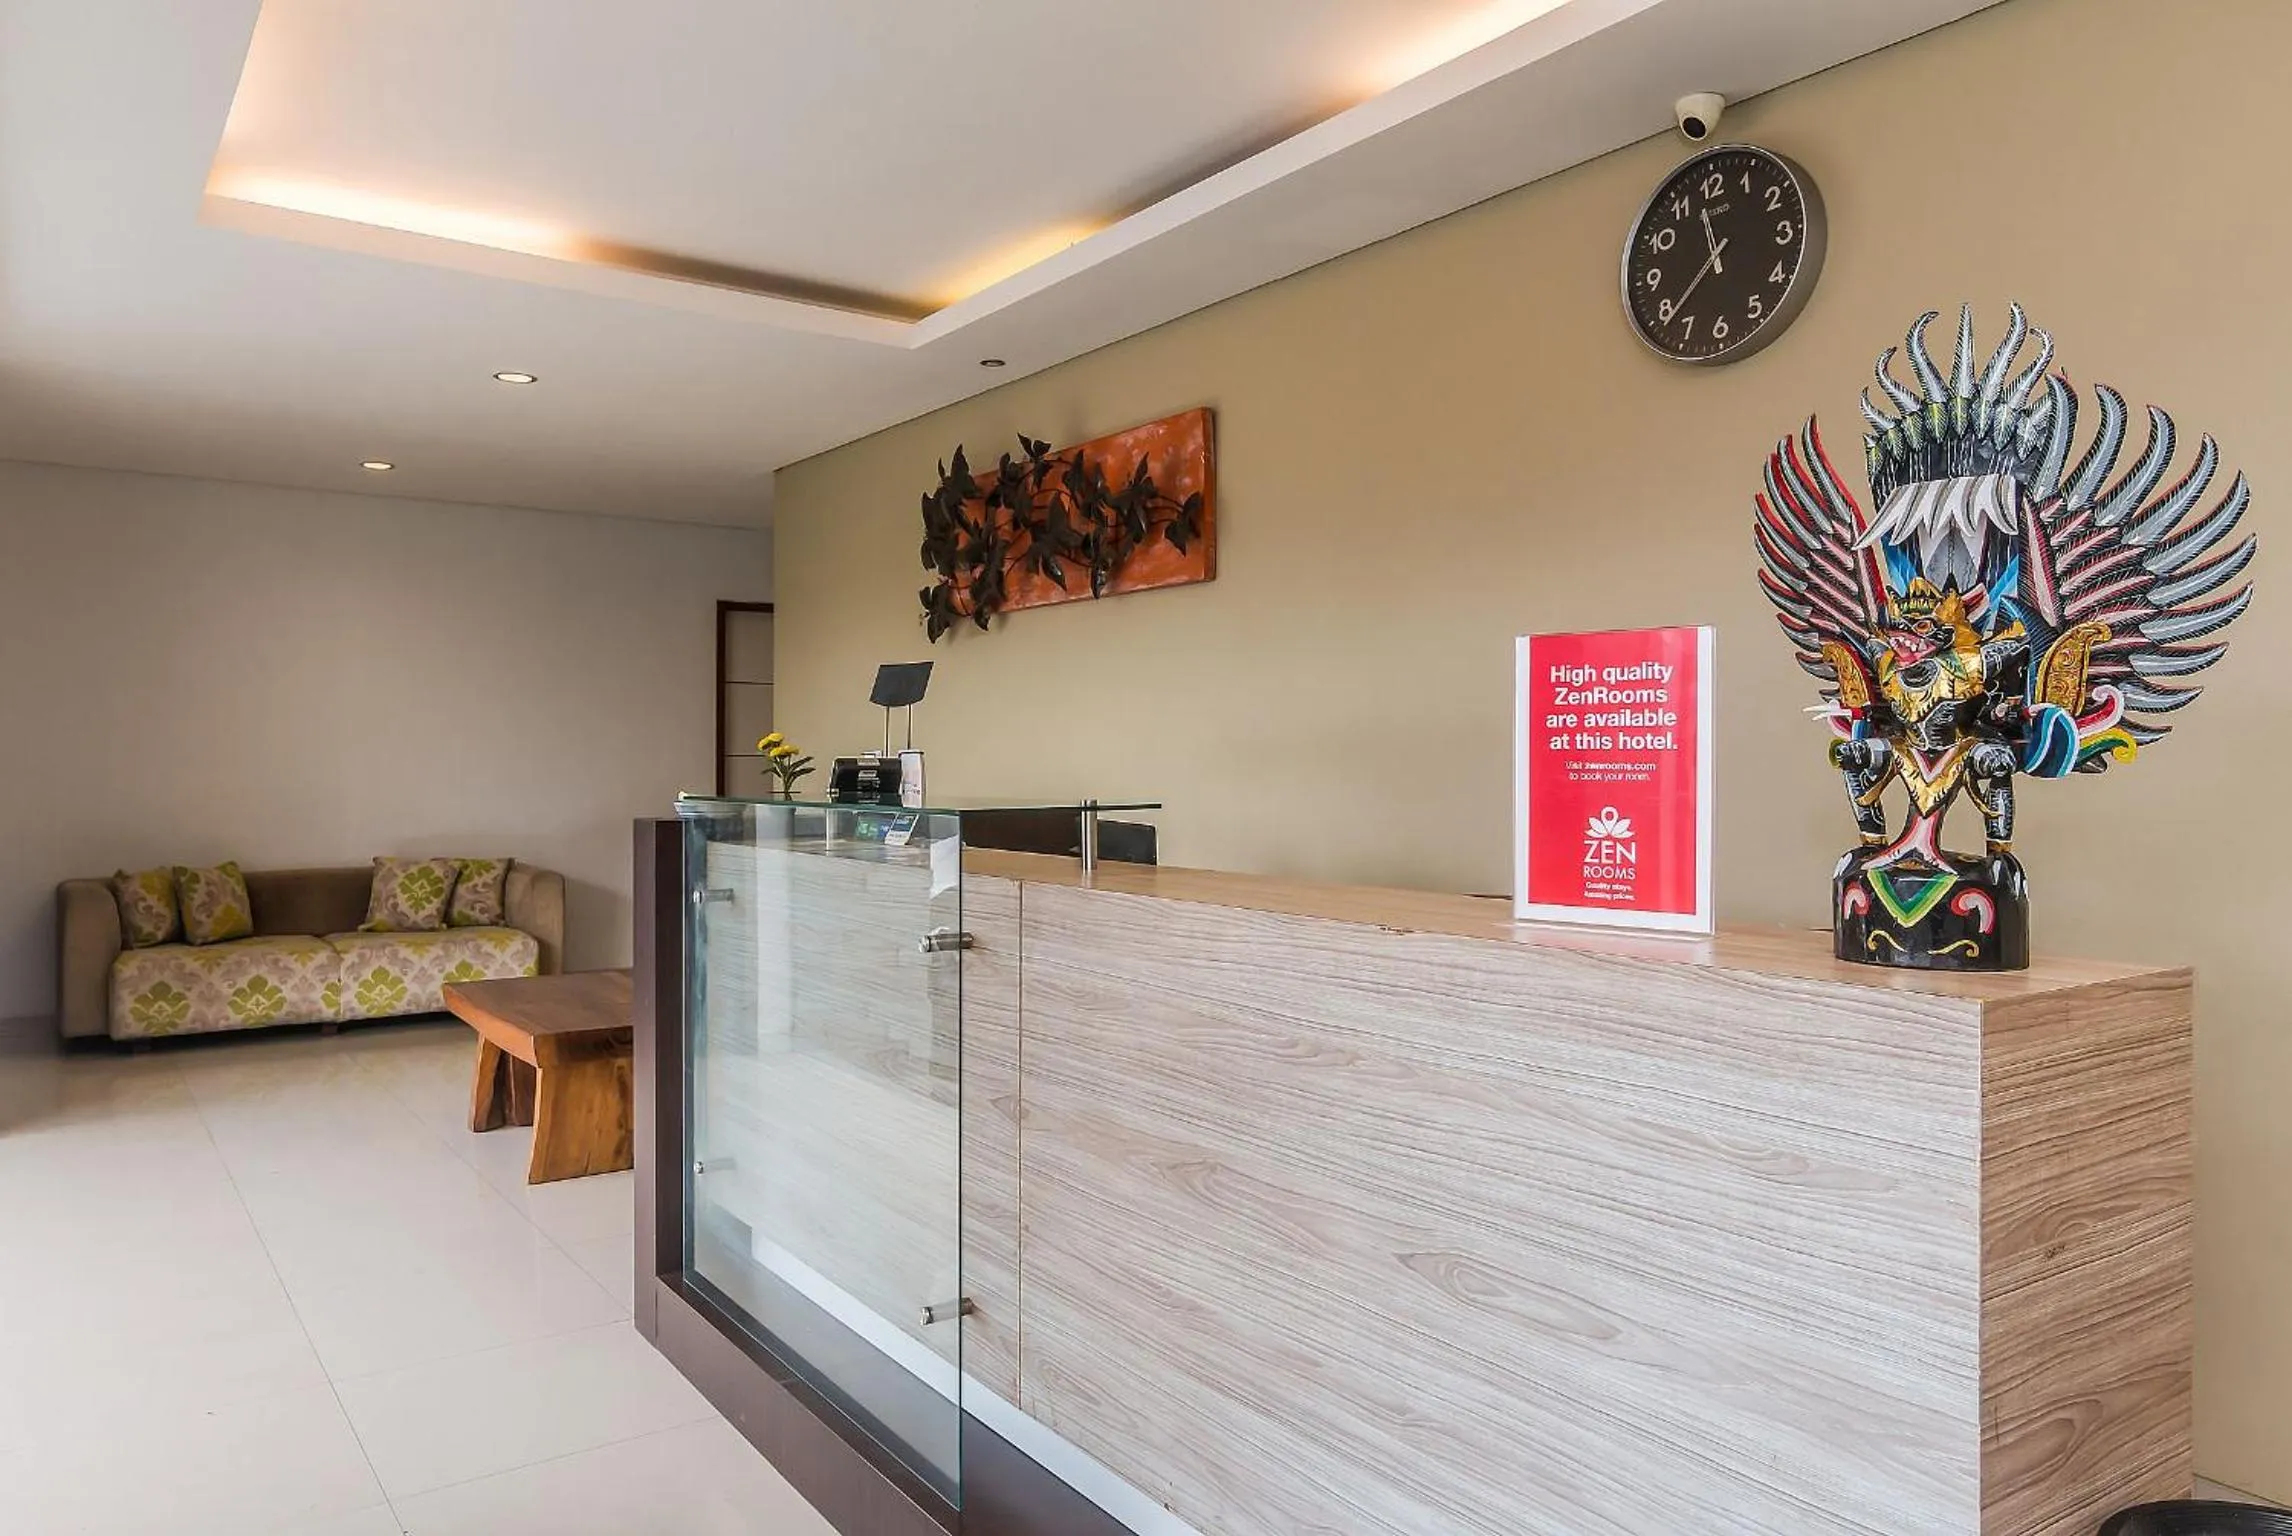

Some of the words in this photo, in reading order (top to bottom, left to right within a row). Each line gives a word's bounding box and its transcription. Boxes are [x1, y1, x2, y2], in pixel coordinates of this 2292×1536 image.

[1700, 173, 1724, 200] 12
[1740, 171, 1750, 193] 1
[1671, 195, 1690, 221] 11
[1764, 186, 1782, 212] 2
[1648, 228, 1676, 254] 10
[1775, 220, 1793, 245] 3
[1646, 268, 1662, 292] 9
[1768, 260, 1786, 284] 4
[1658, 299, 1673, 322] 8
[1747, 294, 1763, 319] 5
[1681, 316, 1695, 340] 7
[1712, 315, 1729, 339] 6
[1550, 664, 1596, 686] High
[1602, 662, 1674, 685] quality
[1554, 687, 1669, 706] ZenRooms
[1545, 713, 1578, 728] are
[1584, 709, 1678, 728] available
[1549, 735, 1570, 750] at
[1575, 732, 1612, 750] this
[1618, 732, 1679, 750] hotel.
[1568, 772, 1579, 780] to
[1581, 772, 1602, 781] book
[1604, 773, 1624, 782] your
[1584, 762, 1657, 772] zenrooms.com
[1583, 840, 1637, 864] ZEN
[1583, 865, 1637, 880] ROOMS
